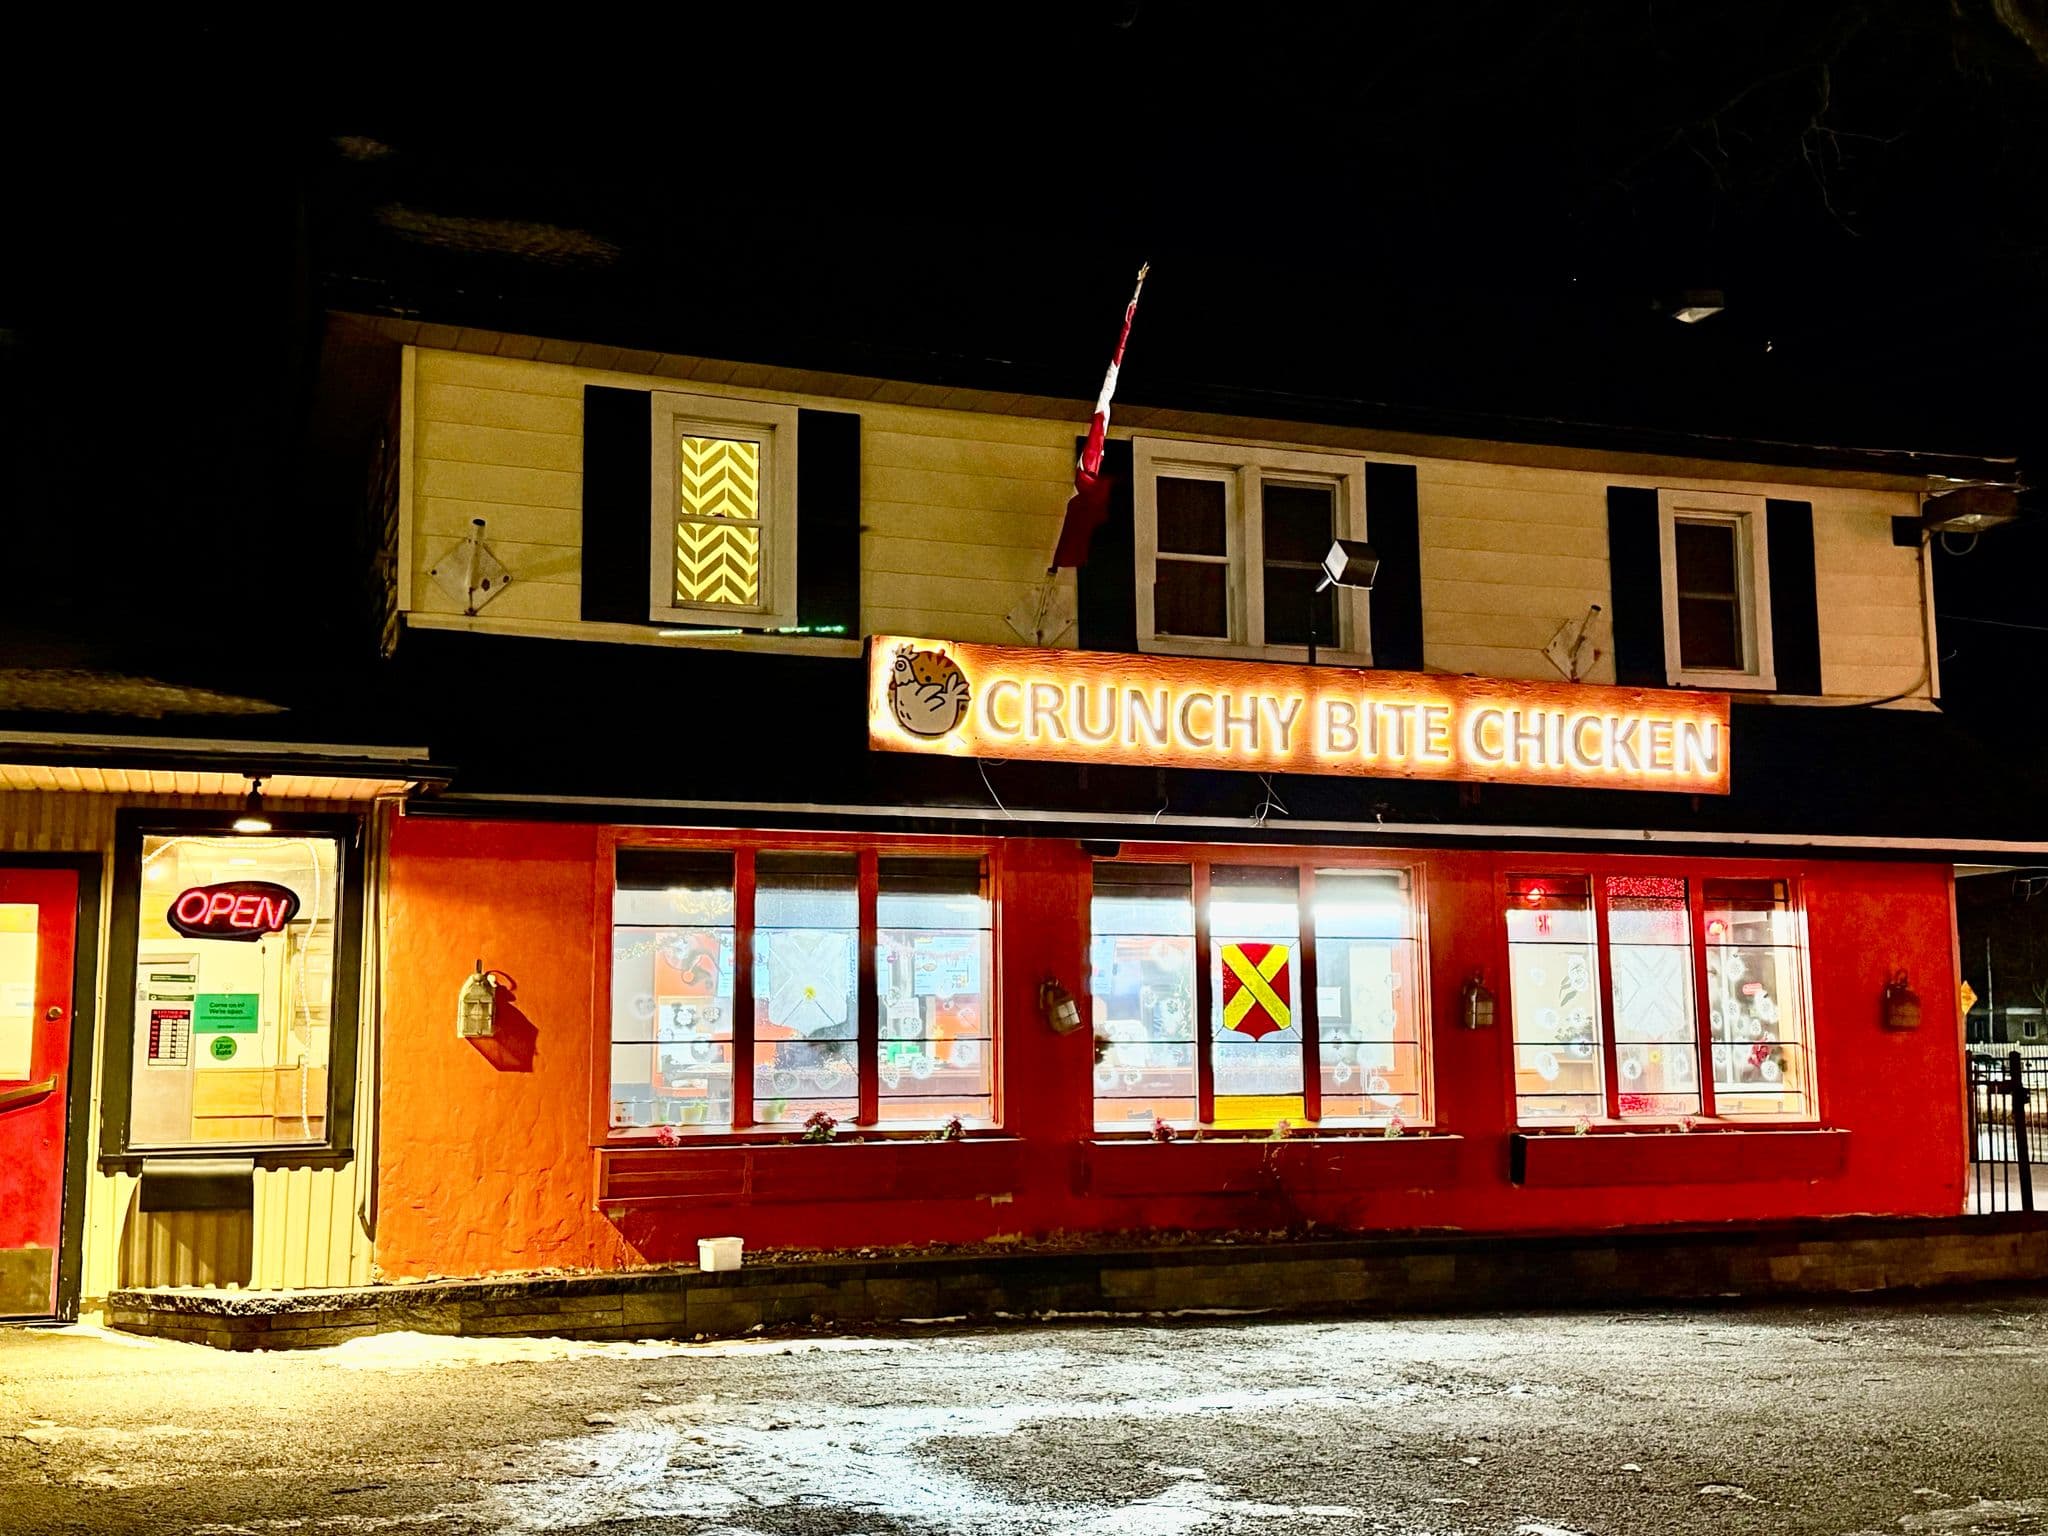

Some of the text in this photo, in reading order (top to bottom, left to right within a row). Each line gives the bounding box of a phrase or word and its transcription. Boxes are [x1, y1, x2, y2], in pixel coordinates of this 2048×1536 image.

[985, 679, 1719, 774] CRUNCHY BITE CHICKEN
[176, 890, 288, 929] OPEN
